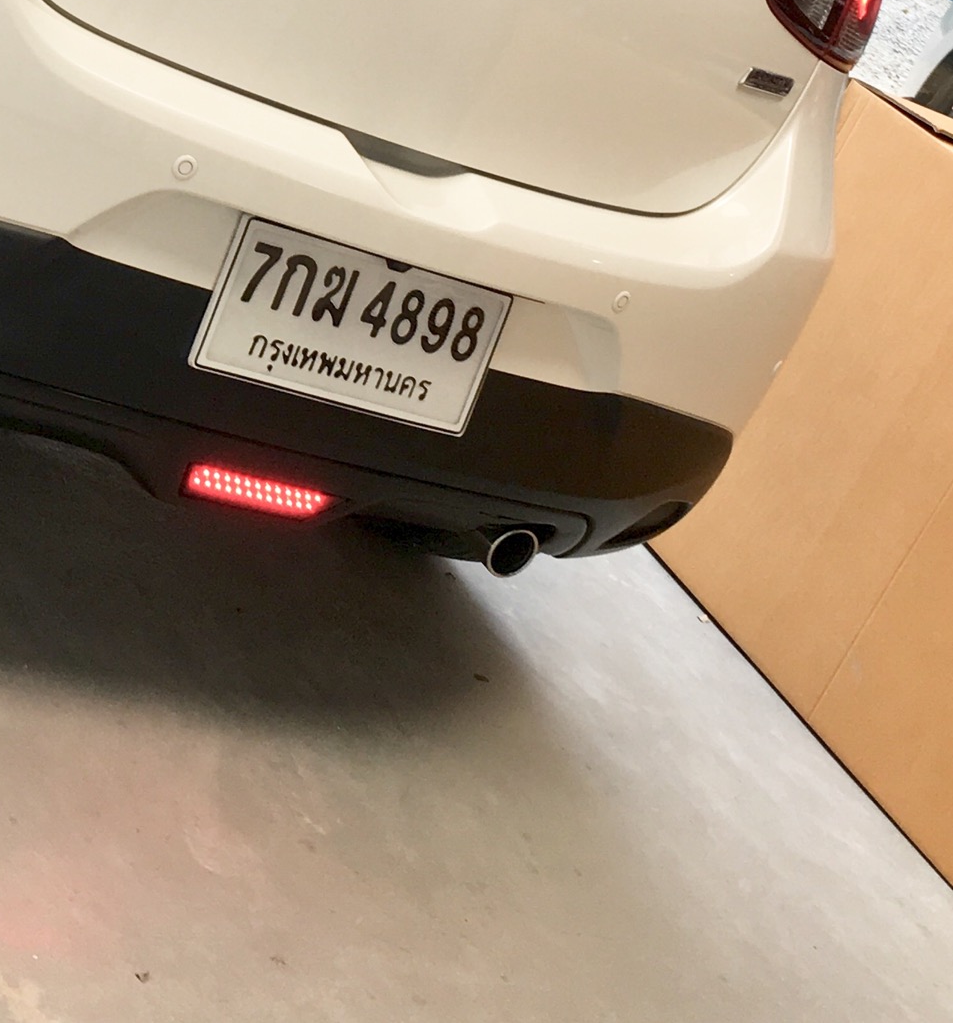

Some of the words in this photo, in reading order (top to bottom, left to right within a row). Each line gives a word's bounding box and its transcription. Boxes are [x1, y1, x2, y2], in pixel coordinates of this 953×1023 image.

[240, 241, 360, 327] 7กฆ
[359, 281, 485, 362] 4898
[248, 334, 432, 401] กรุงเทพมหานคร
